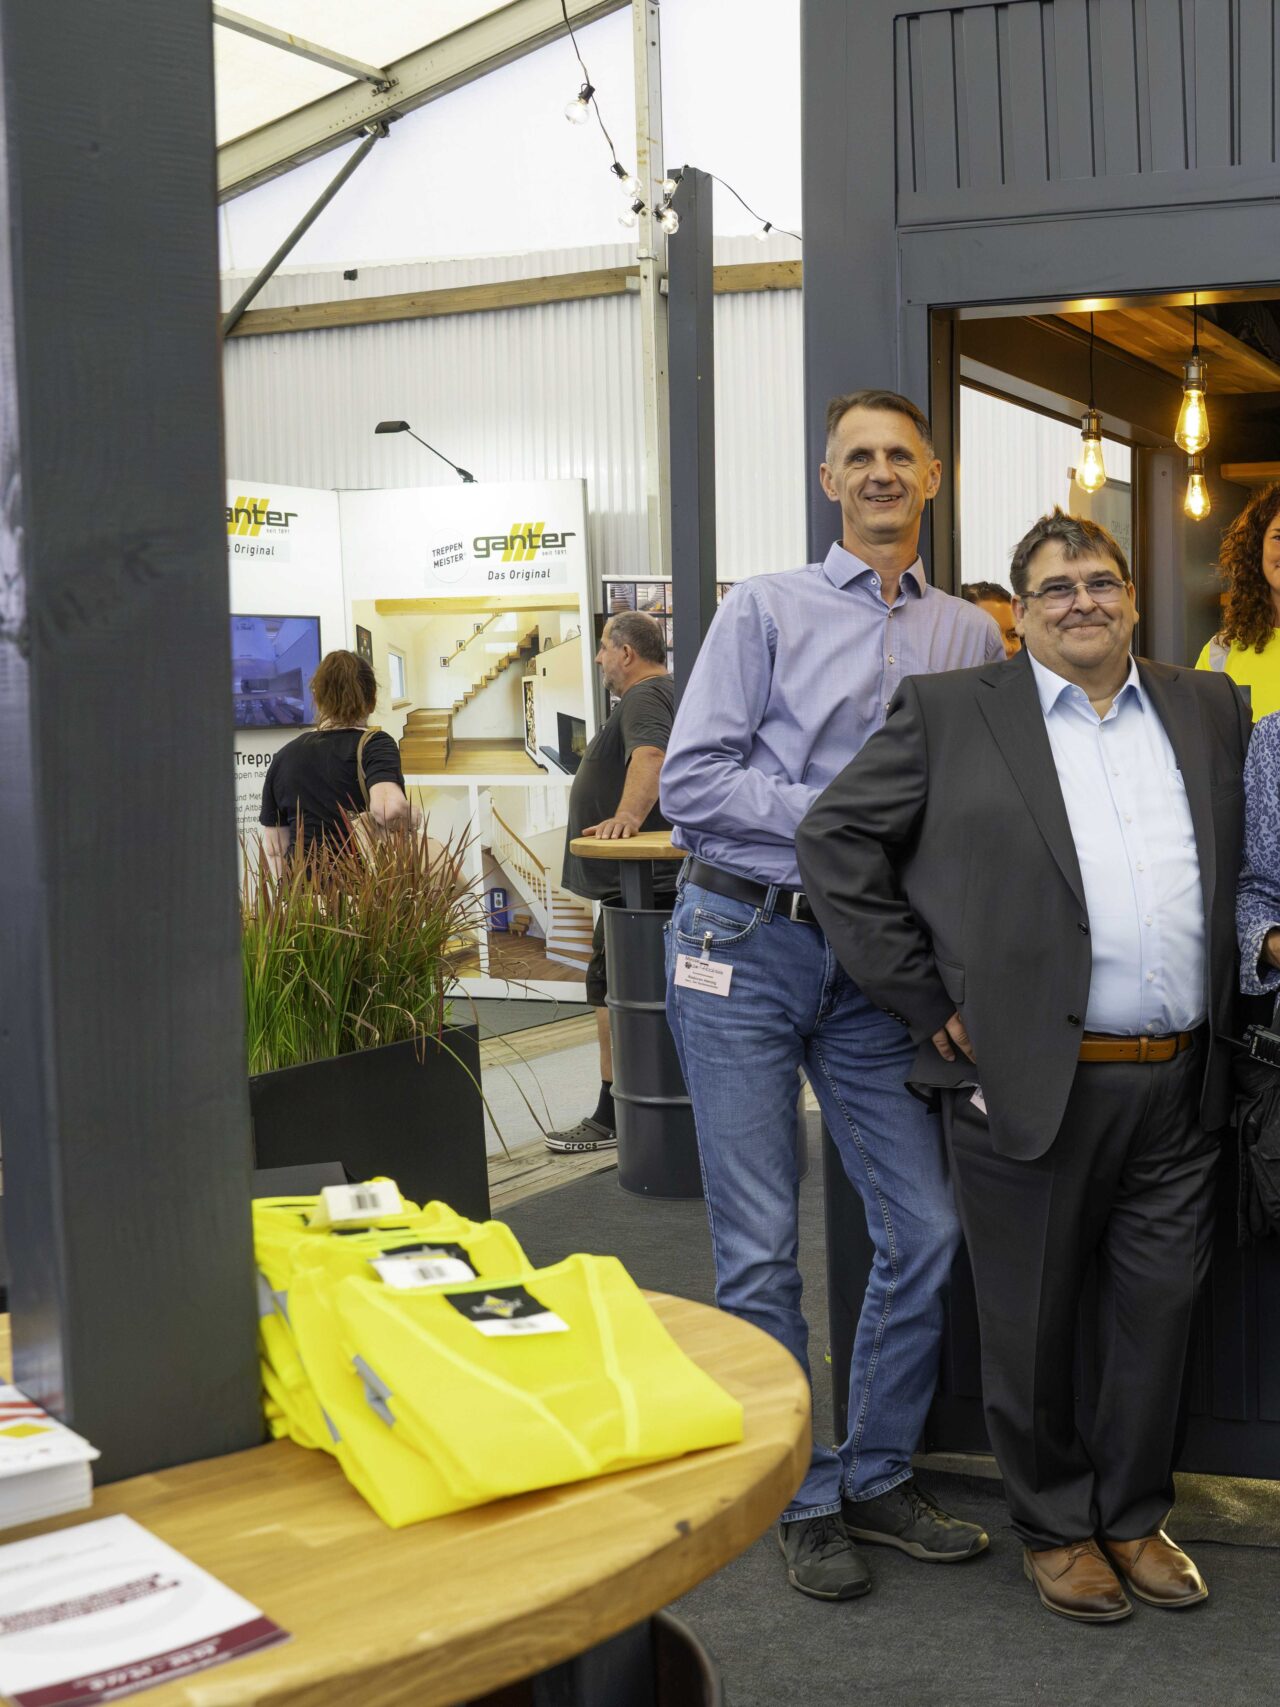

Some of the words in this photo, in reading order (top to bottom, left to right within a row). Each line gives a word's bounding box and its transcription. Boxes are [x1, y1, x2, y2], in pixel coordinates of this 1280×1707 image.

[225, 504, 298, 527] anter
[234, 543, 275, 556] Original
[432, 541, 463, 557] TREPPEN
[473, 528, 576, 558] ganter
[433, 553, 464, 568] MEISTER
[488, 570, 505, 580] Das
[509, 568, 551, 581] Original
[564, 1142, 598, 1150] crocs
